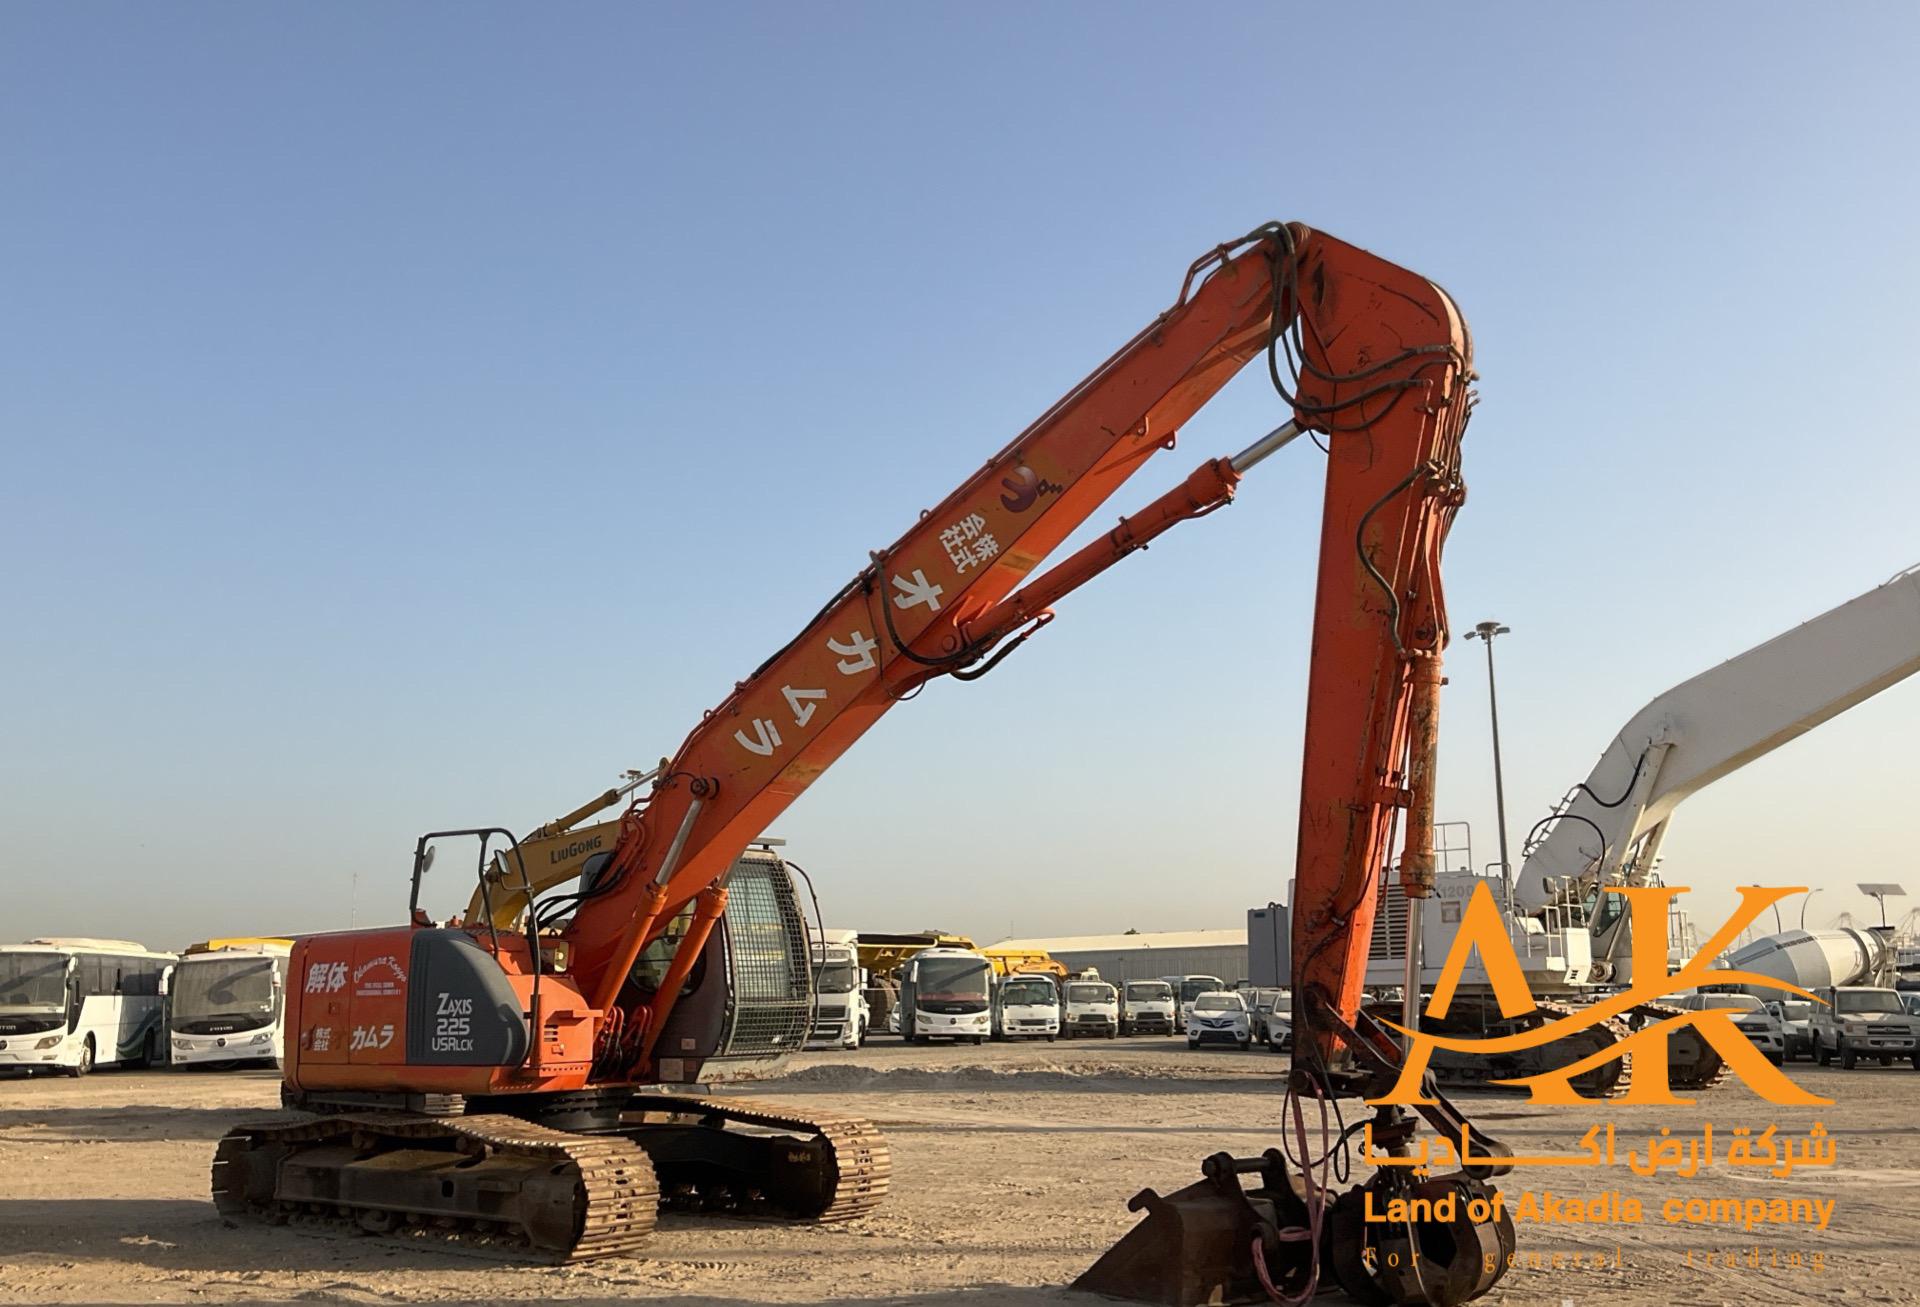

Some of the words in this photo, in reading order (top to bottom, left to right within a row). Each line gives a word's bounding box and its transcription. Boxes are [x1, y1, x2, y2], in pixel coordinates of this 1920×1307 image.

[305, 962, 349, 993] 解体
[436, 1017, 470, 1035] 225
[350, 1025, 394, 1050] カムラ
[432, 1037, 473, 1051] USRLCK
